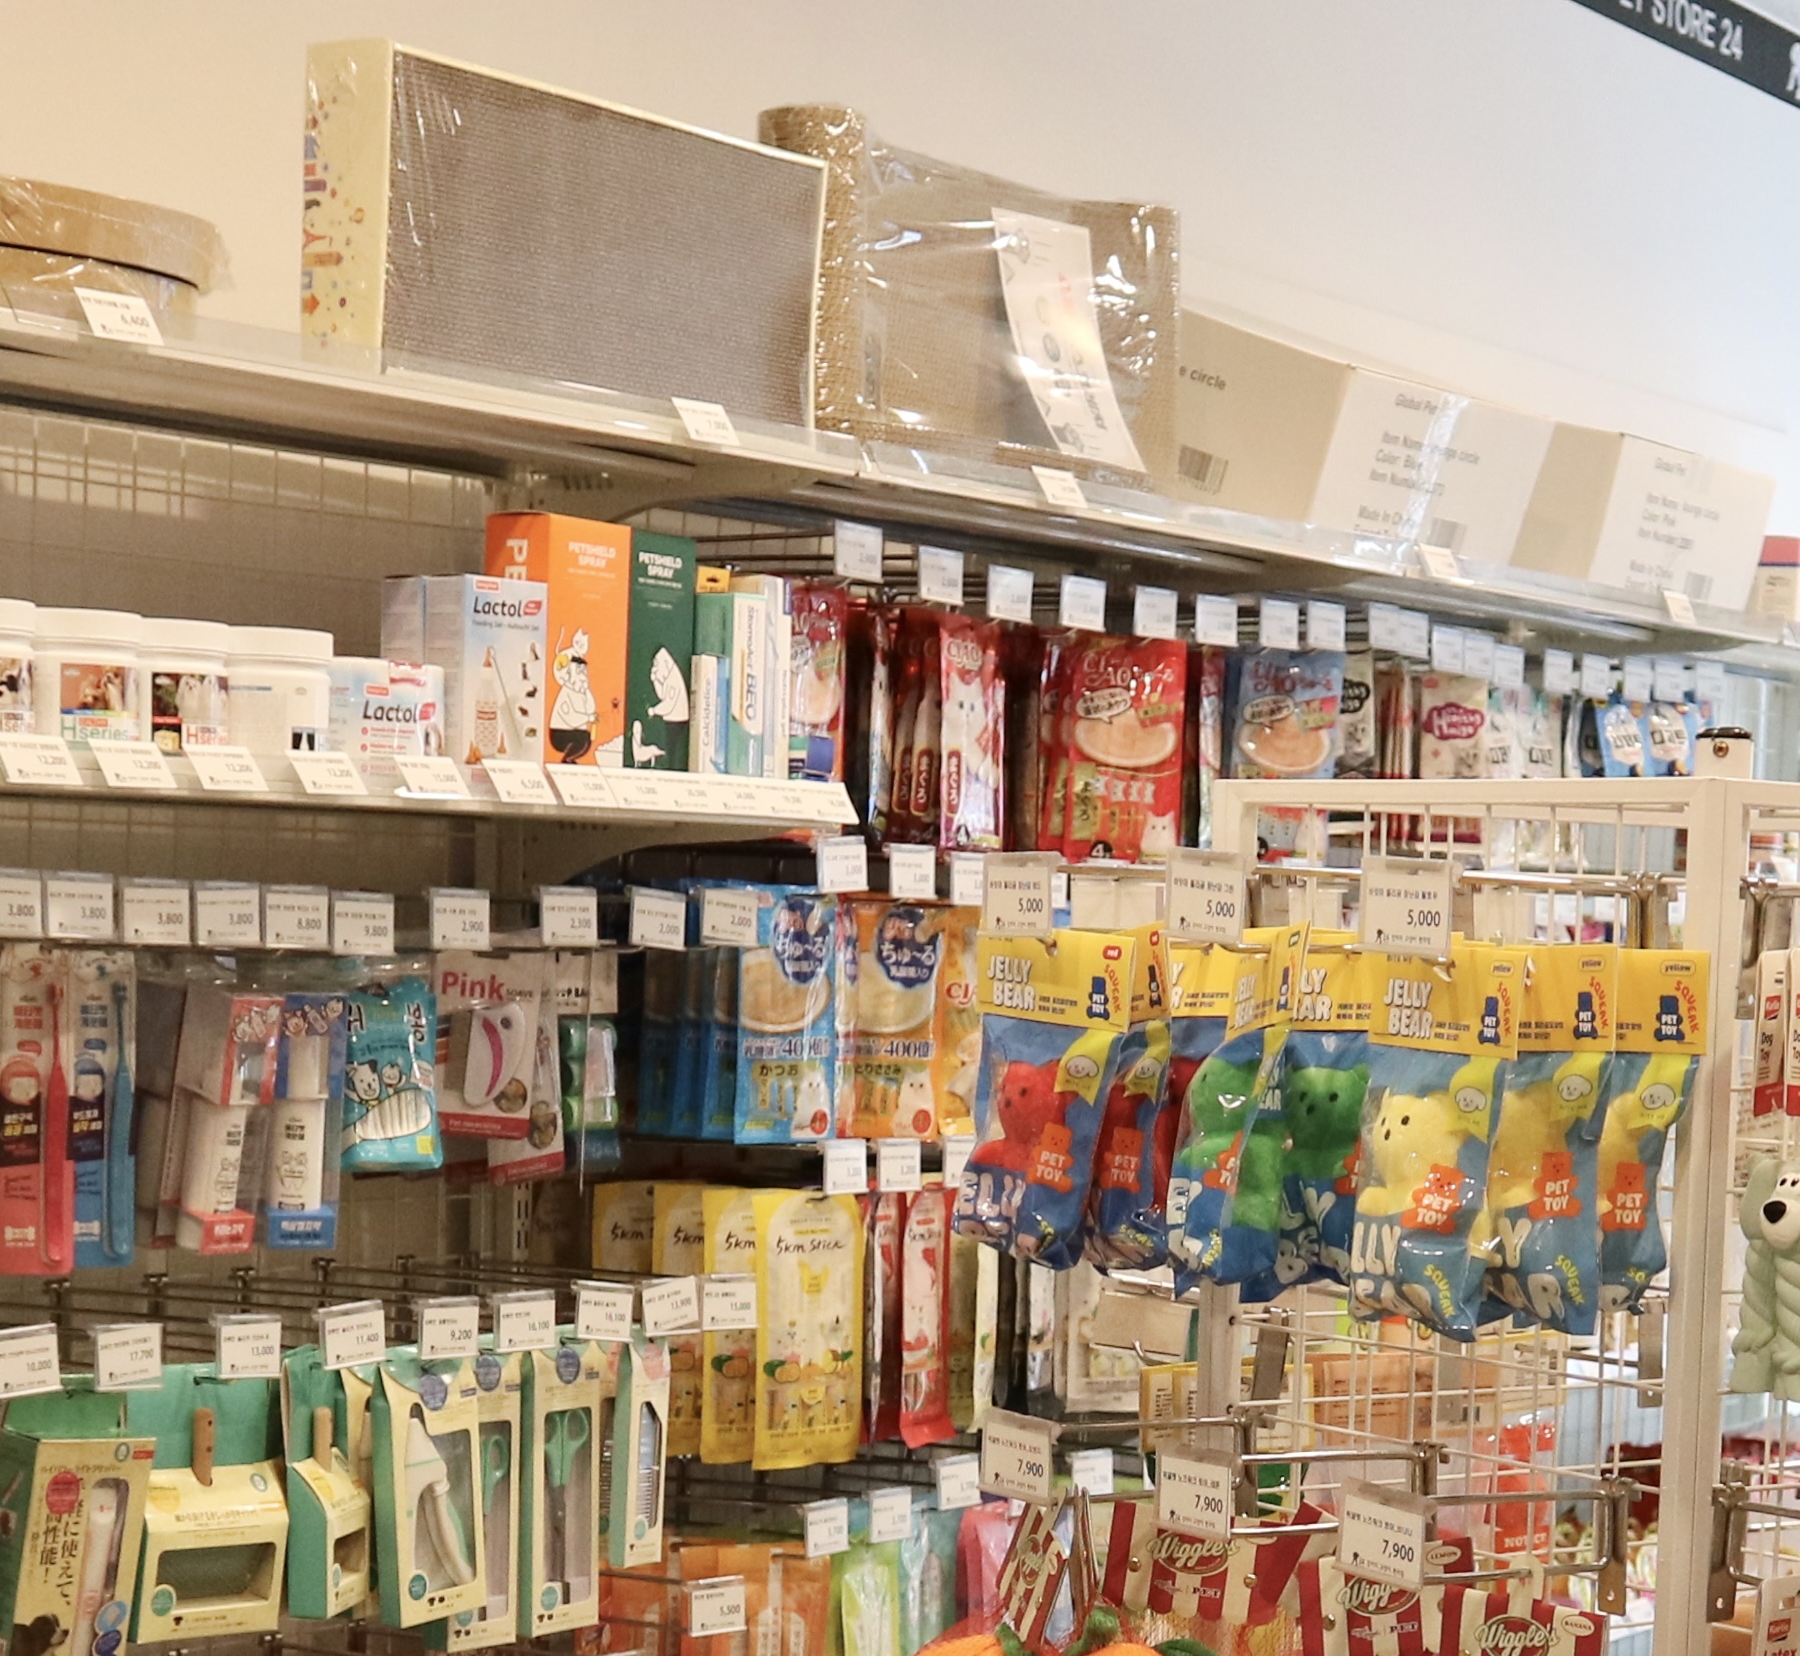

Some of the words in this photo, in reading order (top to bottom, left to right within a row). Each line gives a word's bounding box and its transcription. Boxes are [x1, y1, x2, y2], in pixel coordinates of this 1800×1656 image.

[1651, 0, 1716, 48] STORE
[1719, 17, 1744, 61] 24
[638, 551, 683, 569] PETSHIELD
[647, 565, 675, 580] SPRAY
[473, 596, 523, 618] Lactol
[362, 700, 418, 723] Lactol
[1018, 897, 1044, 913] 5,000
[1406, 909, 1441, 928] 5,000
[986, 955, 1033, 984] JELLY
[1664, 962, 1692, 974] yellow
[441, 971, 503, 999] Pink
[1103, 963, 1122, 1013] SQUEAK
[1384, 978, 1432, 1009] JELLY
[992, 982, 1036, 1012] BEAR
[1674, 980, 1699, 1034] SQUEAK
[1388, 1009, 1434, 1040] BEAR
[1545, 1178, 1570, 1195] PET
[1543, 1194, 1570, 1211] TOY
[1194, 1494, 1224, 1514] 7,900
[1382, 1539, 1415, 1563] 7,900
